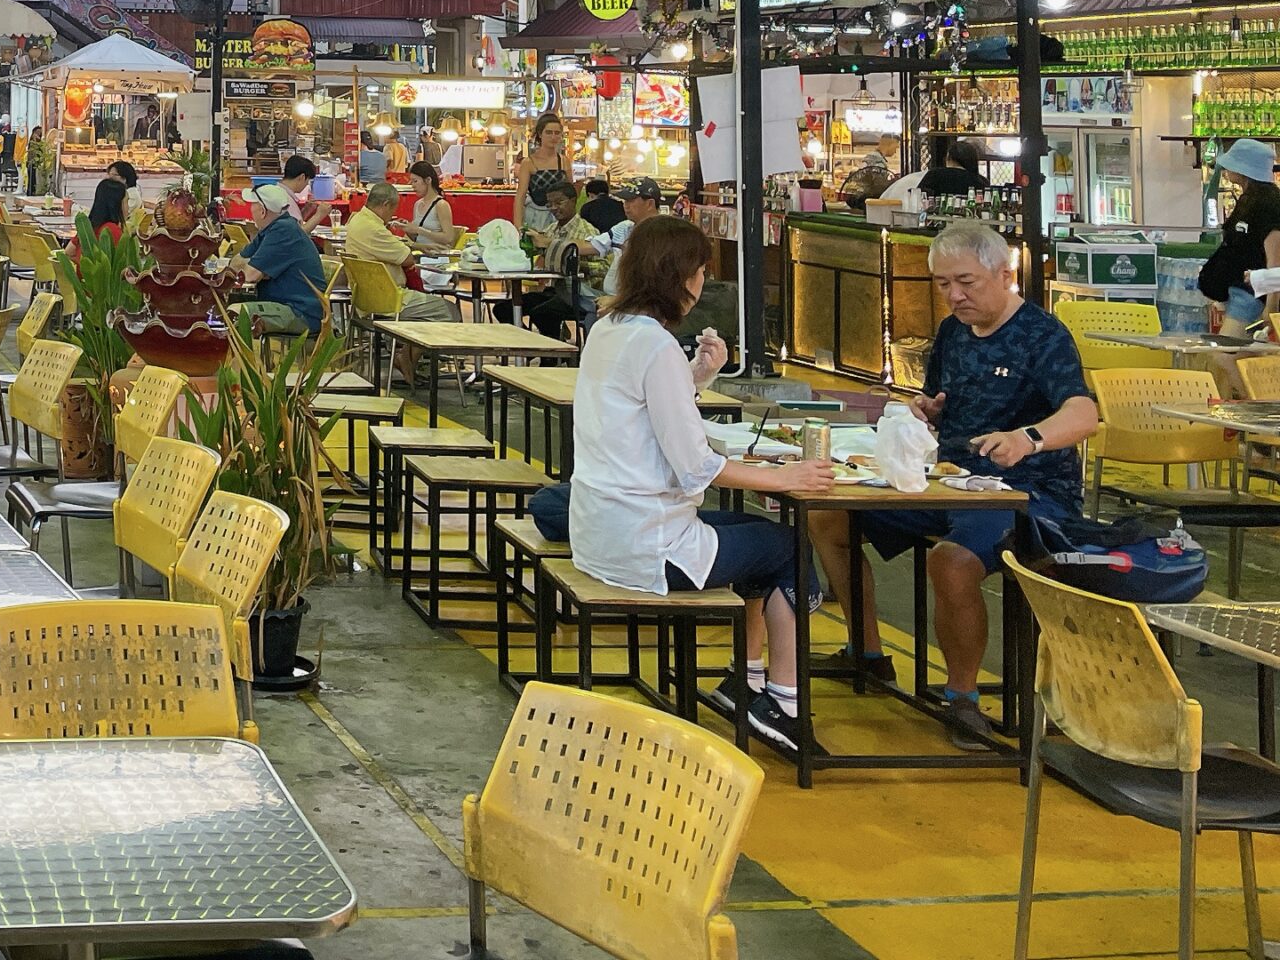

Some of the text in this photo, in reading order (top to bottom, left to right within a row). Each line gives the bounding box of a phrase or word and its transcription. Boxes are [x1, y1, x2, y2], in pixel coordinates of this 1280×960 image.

[195, 39, 253, 54] MTER
[195, 57, 244, 69] BUGER
[1111, 266, 1137, 276] Chang
